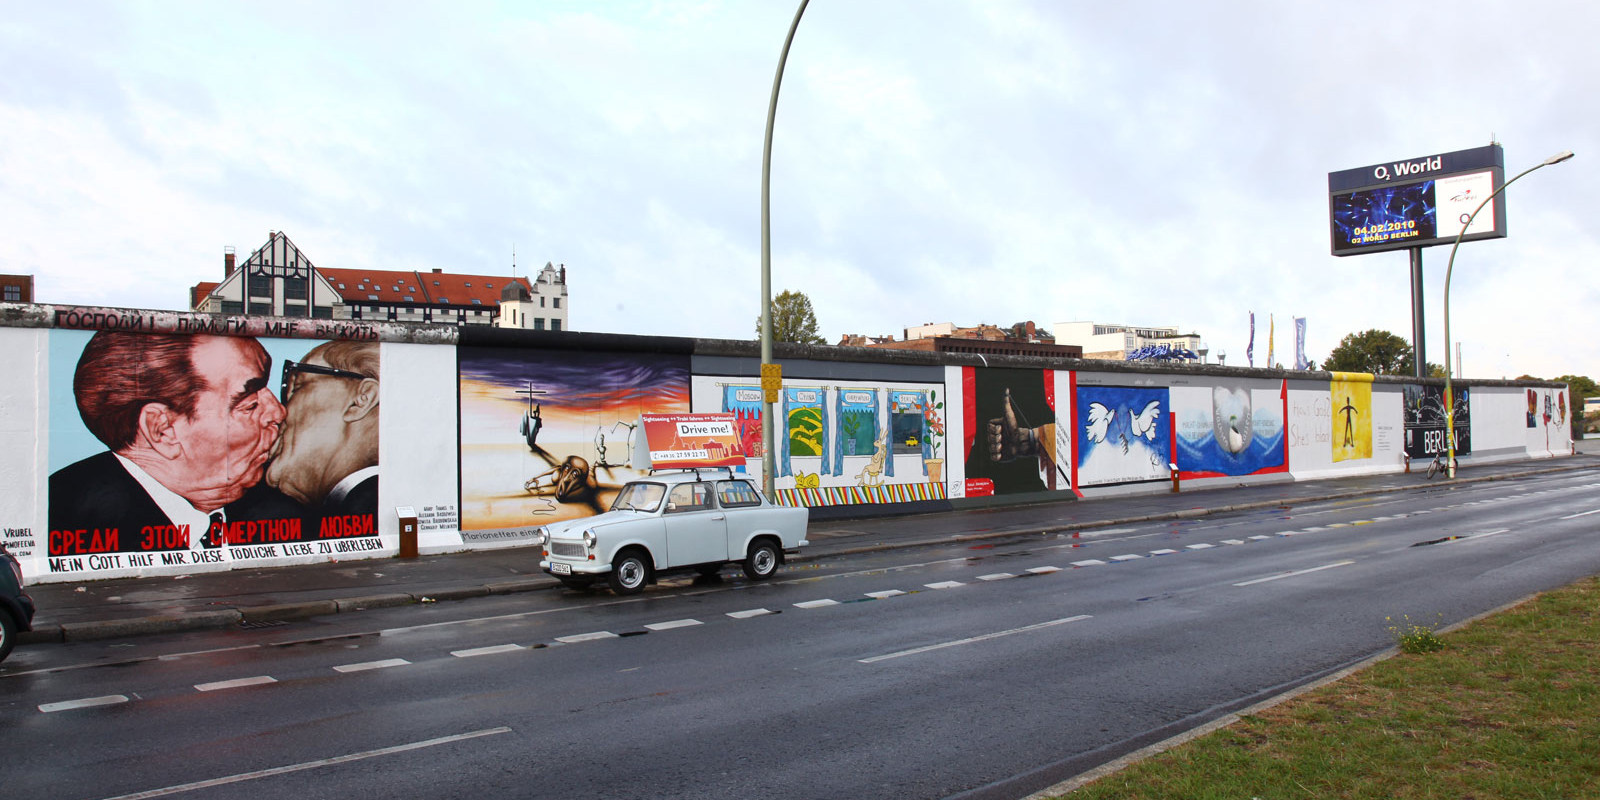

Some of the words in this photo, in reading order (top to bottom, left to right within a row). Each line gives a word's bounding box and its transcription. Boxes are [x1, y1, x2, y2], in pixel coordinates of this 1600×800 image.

[1394, 156, 1442, 177] World
[1354, 220, 1416, 236] 04.02.2010
[1363, 234, 1390, 243] WORLD
[1390, 230, 1419, 240] BERLIN
[681, 425, 708, 434] Drive
[711, 424, 729, 434] me!
[1424, 430, 1458, 454] BERLN
[4, 527, 34, 538] VRUBEL
[50, 527, 120, 556] СРЕДИ
[140, 523, 191, 551] ЭТОЙ
[318, 513, 379, 539] ЛЮБВИ.
[461, 530, 518, 541] Marionetten
[318, 541, 332, 555] ZU
